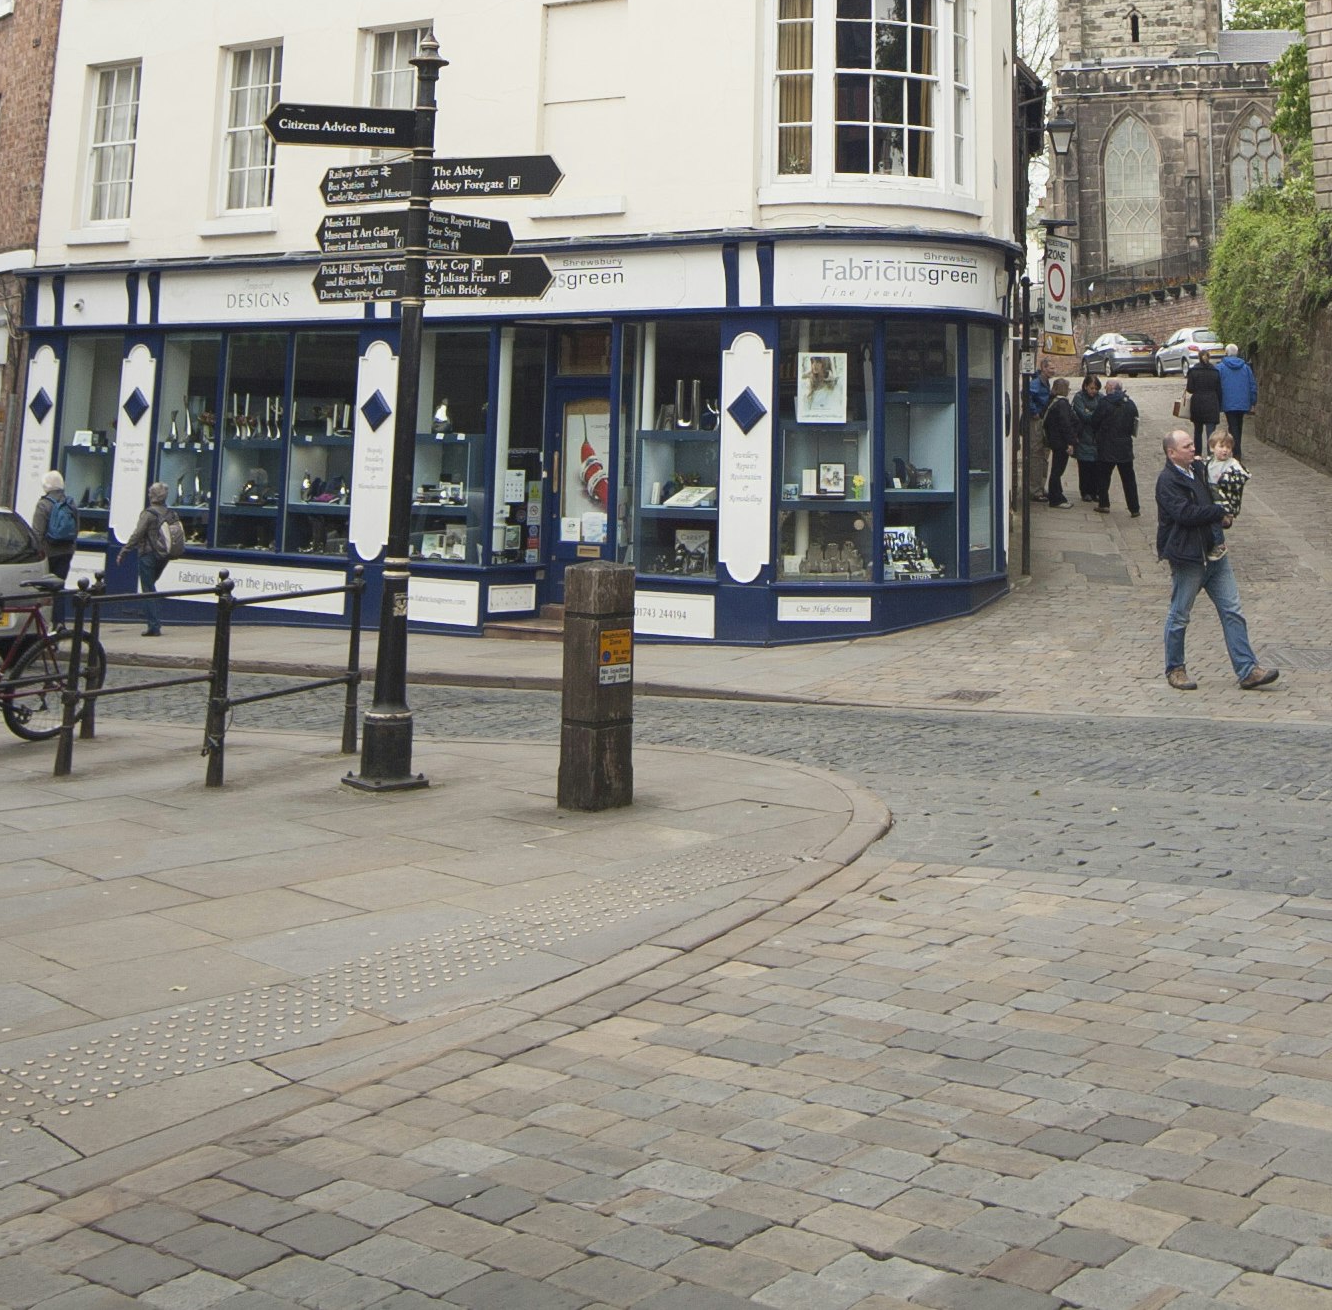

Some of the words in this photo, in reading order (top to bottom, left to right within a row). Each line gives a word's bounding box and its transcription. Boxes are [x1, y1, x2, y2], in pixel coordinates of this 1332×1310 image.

[278, 118, 320, 131] Citizens
[321, 121, 357, 132] Advice
[359, 122, 396, 134] Bureau
[328, 168, 352, 180] Railway
[354, 167, 379, 178] Station
[432, 166, 451, 177] The
[453, 165, 484, 178] Abbey
[327, 181, 340, 191] Bus
[341, 180, 365, 191] Station
[431, 180, 462, 192] Abbey
[464, 179, 504, 192] Foregate
[383, 189, 412, 198] Museum
[324, 217, 345, 228] Music
[345, 216, 361, 227] Hall
[428, 212, 449, 225] Prince
[450, 215, 472, 229] Rupert
[473, 219, 491, 230] Hotel
[324, 230, 352, 240] Museum
[359, 228, 372, 238] Art
[372, 226, 400, 239] Gallery
[428, 225, 443, 236] Bear
[444, 228, 462, 240] Steps
[323, 241, 346, 252] Tourist
[347, 240, 388, 251] Information
[428, 238, 450, 249] Toilets
[923, 252, 978, 266] Shrewsbury
[1047, 249, 1066, 262] ZONE
[321, 265, 337, 275] Pride
[338, 264, 352, 274] Hill
[352, 263, 384, 276] Shopping
[384, 261, 406, 272] Centre
[426, 259, 448, 271] Wyle
[450, 259, 470, 271] Cop
[562, 257, 623, 268] Shrewsbury
[822, 258, 978, 286] Fabriciusgreen
[325, 278, 337, 287] and
[338, 276, 368, 286] Riverside
[368, 273, 384, 284] Mall
[424, 273, 437, 284] St.
[438, 273, 469, 285] Julians
[471, 273, 496, 284] Friars
[320, 290, 343, 300] Darwin
[344, 288, 374, 301] Shopping
[375, 287, 398, 297] Centre
[424, 284, 456, 296] English
[458, 284, 488, 297] Bridge
[821, 285, 856, 299] fine
[863, 286, 914, 300] jewels
[226, 292, 290, 309] DESIGNS
[178, 570, 215, 585] Fabricius
[245, 576, 260, 590] the
[261, 577, 304, 593] jewellers
[658, 609, 687, 620] 244194
[796, 605, 811, 613] One
[812, 605, 831, 616] High
[832, 605, 853, 614] Street
